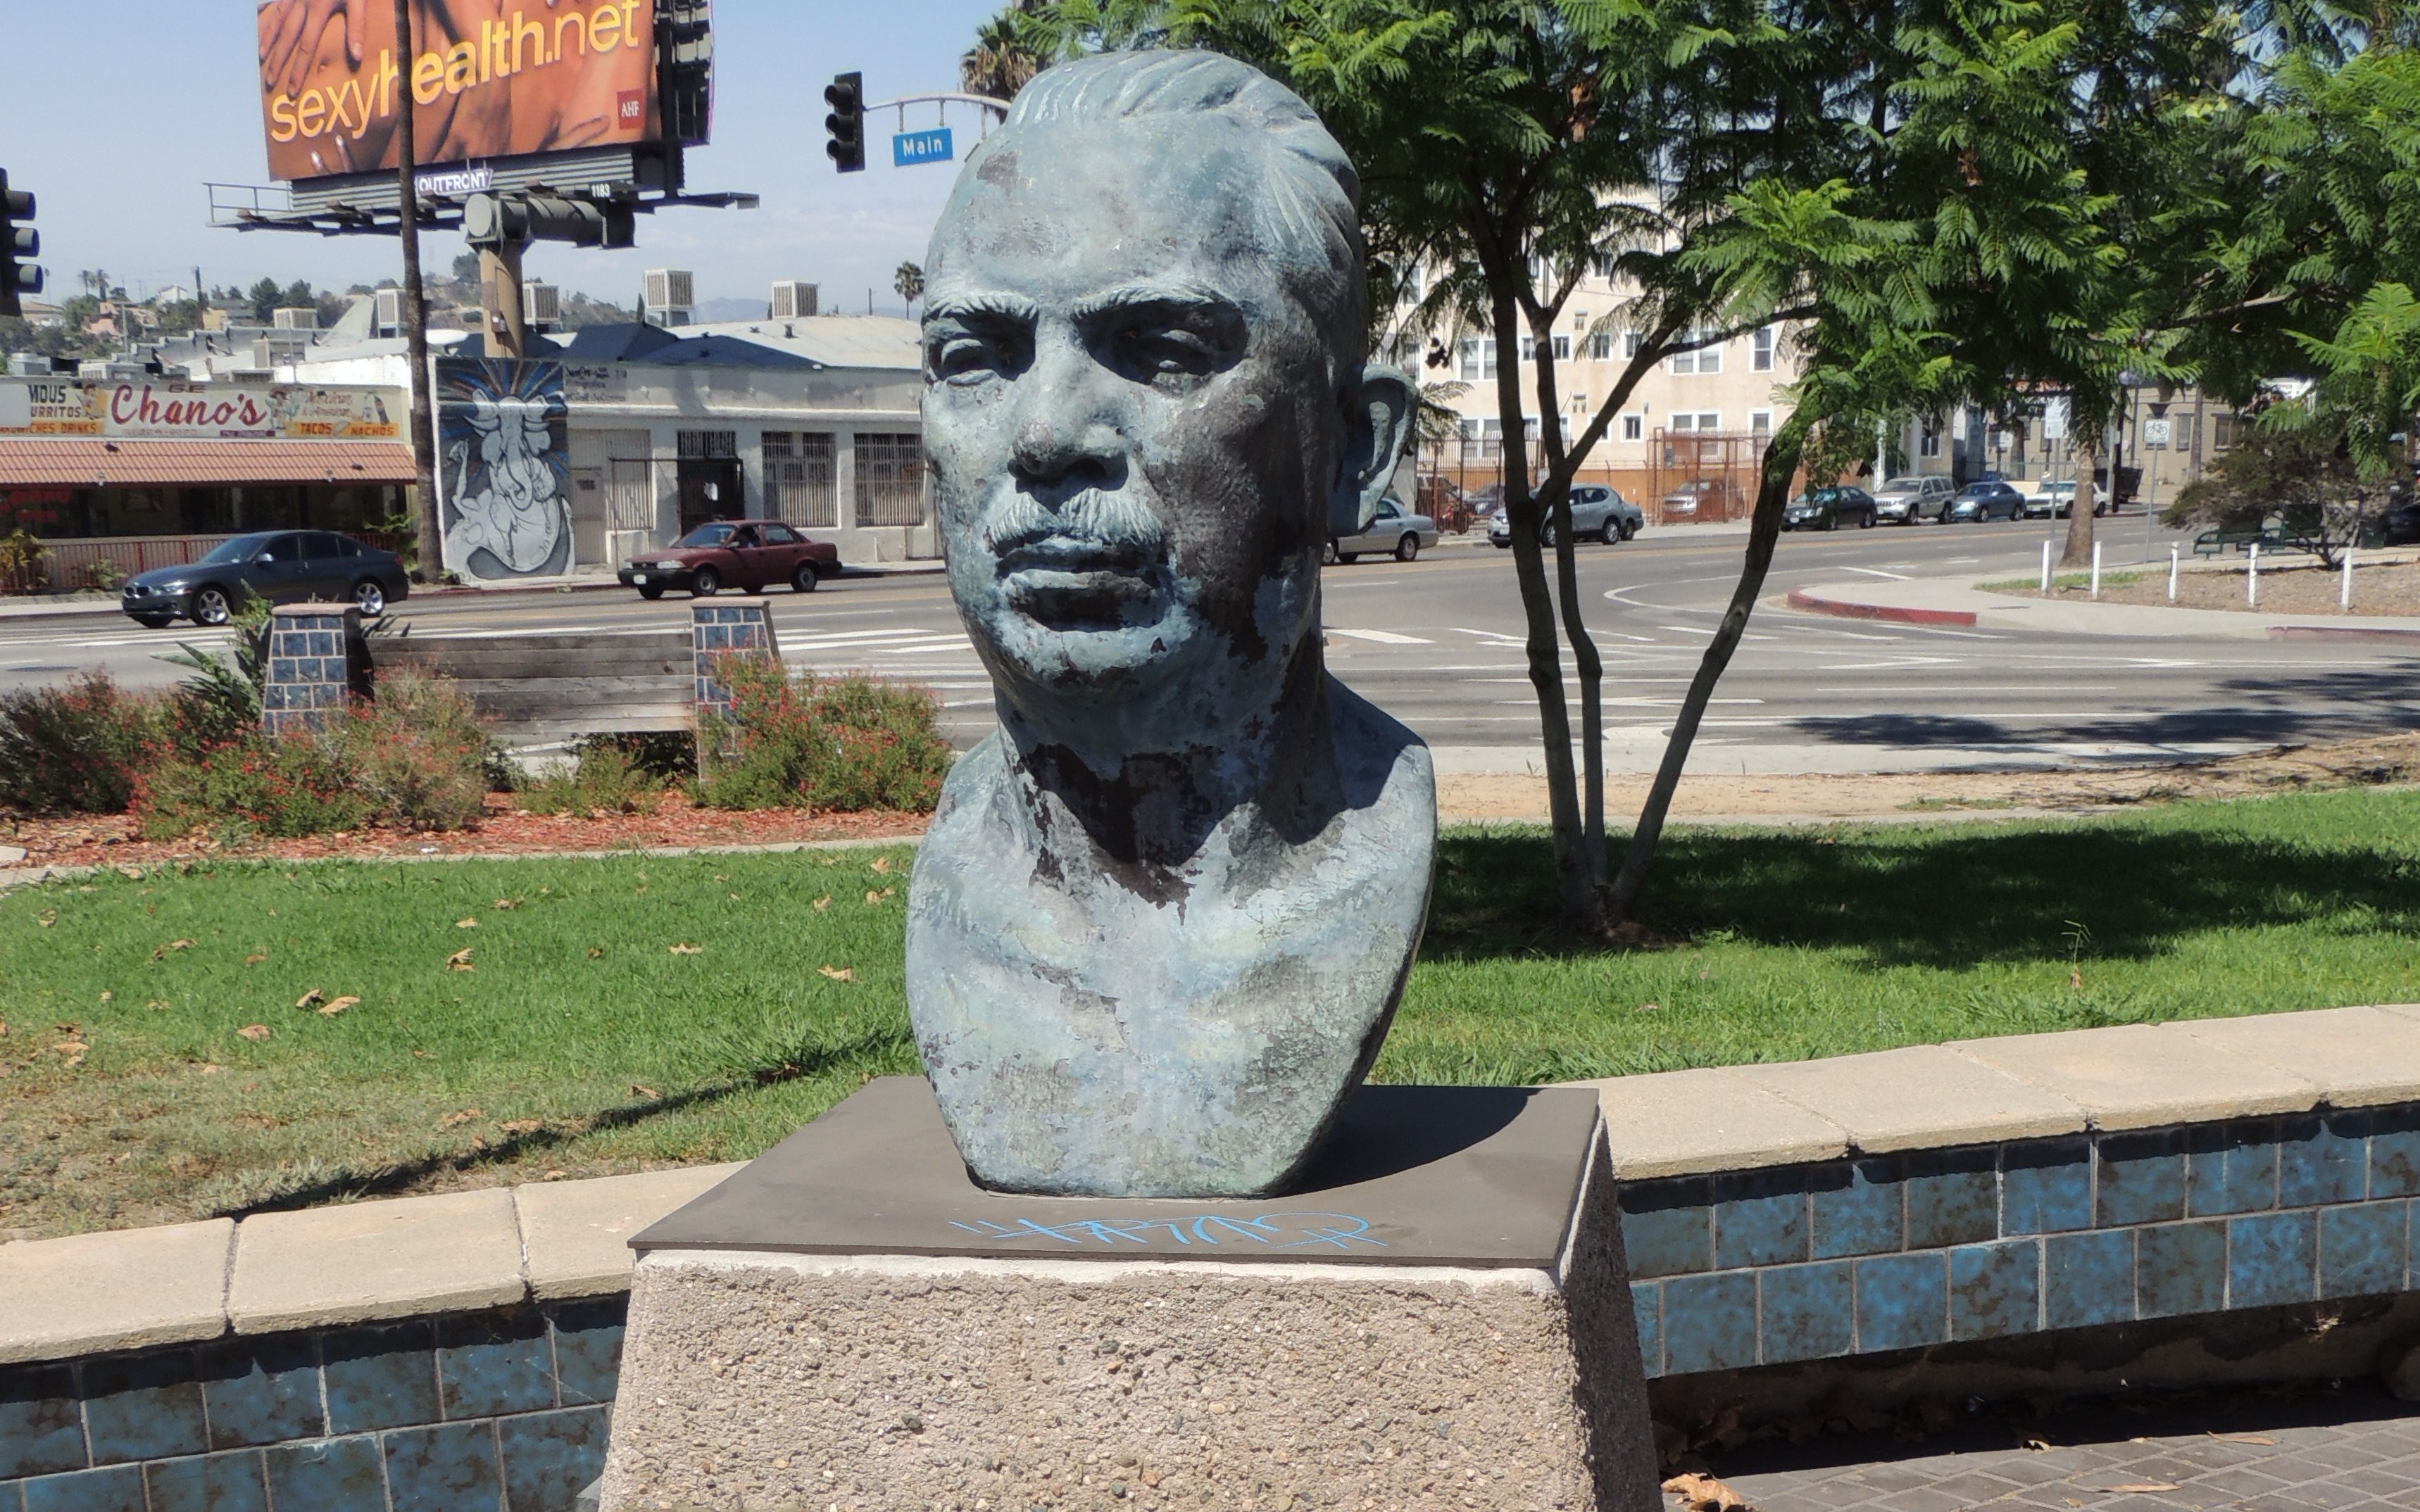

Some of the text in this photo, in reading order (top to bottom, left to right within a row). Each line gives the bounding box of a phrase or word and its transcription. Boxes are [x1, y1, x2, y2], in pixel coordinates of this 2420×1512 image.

[270, 0, 639, 142] sexyhealth.net
[621, 100, 639, 118] AHF
[903, 137, 943, 157] Main
[419, 172, 486, 192] OUTFRONT
[28, 384, 67, 403] MOUS
[30, 405, 82, 417] URRITOS
[111, 384, 268, 427] Chano's
[61, 422, 96, 434] DRINKS
[300, 422, 333, 435] TACOS
[351, 426, 394, 436] NACHOS
